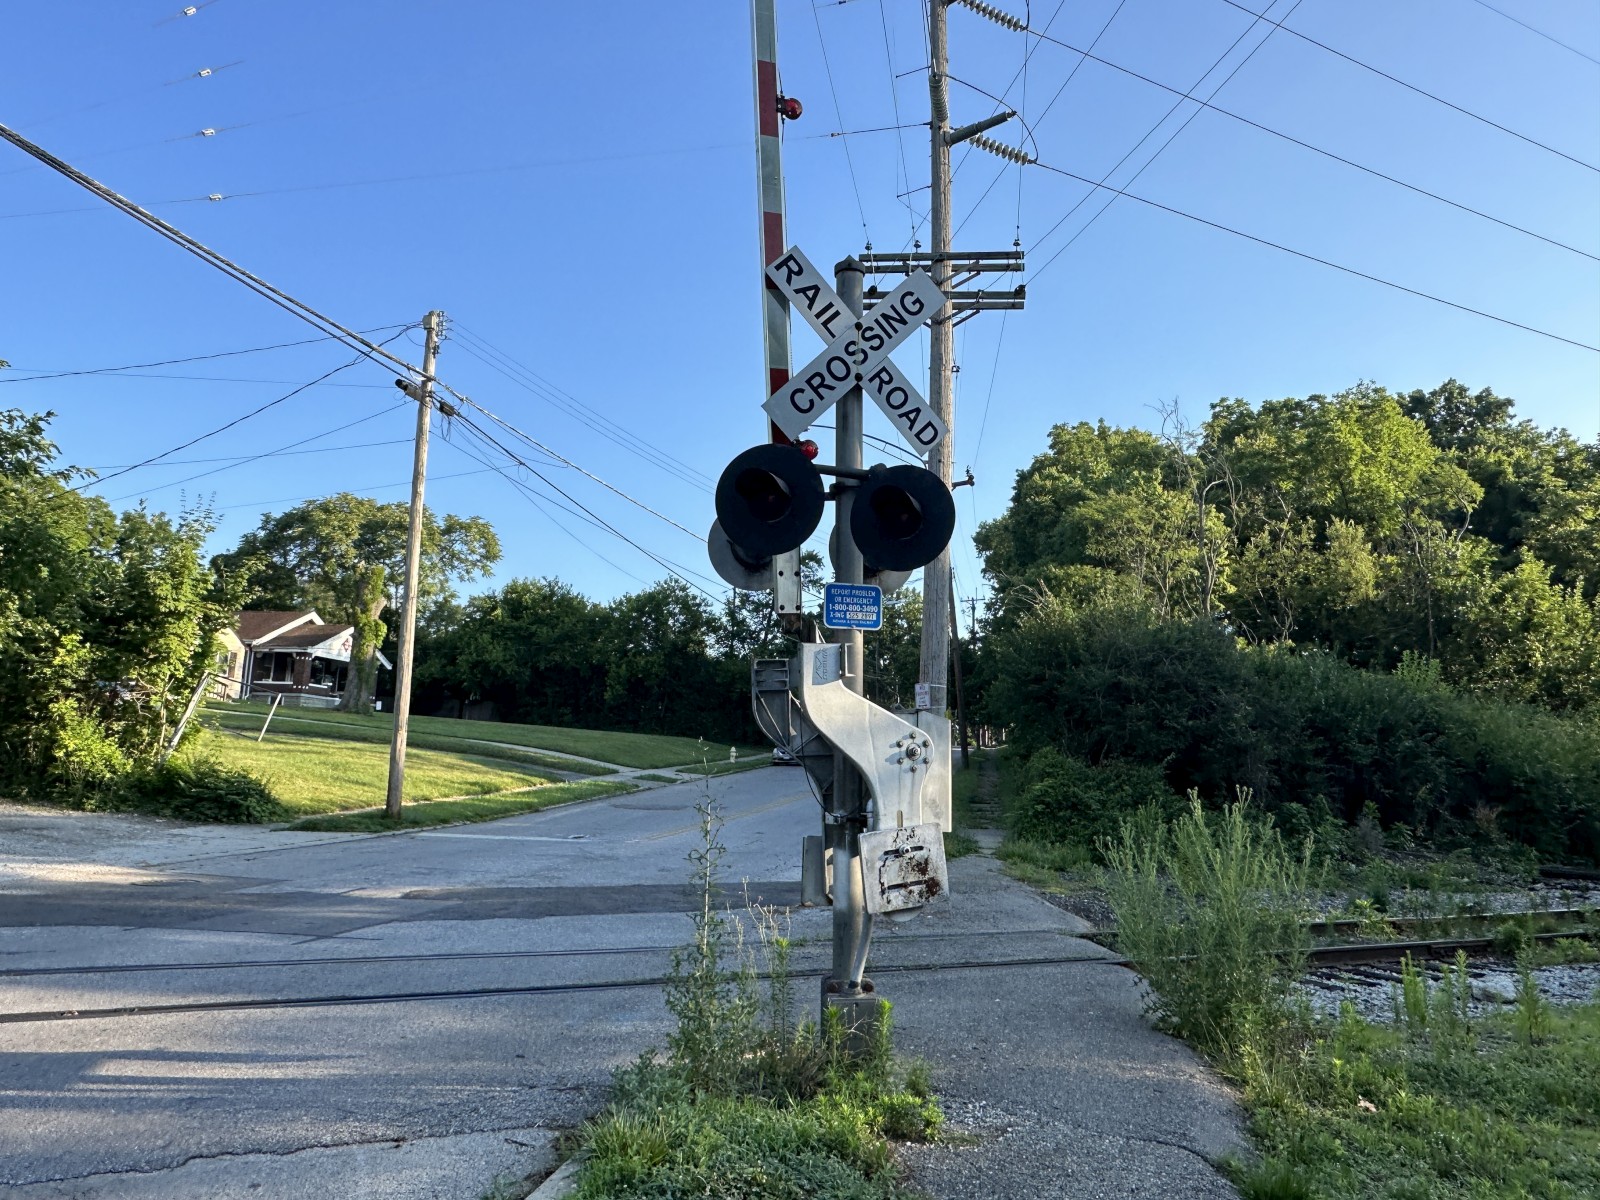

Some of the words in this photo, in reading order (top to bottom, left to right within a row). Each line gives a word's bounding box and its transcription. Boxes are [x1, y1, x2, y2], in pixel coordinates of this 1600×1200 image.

[774, 253, 841, 339] RAIL
[789, 290, 925, 414] CROSSING
[868, 366, 939, 446] ROAD
[829, 604, 878, 612] 1-800-800-3490
